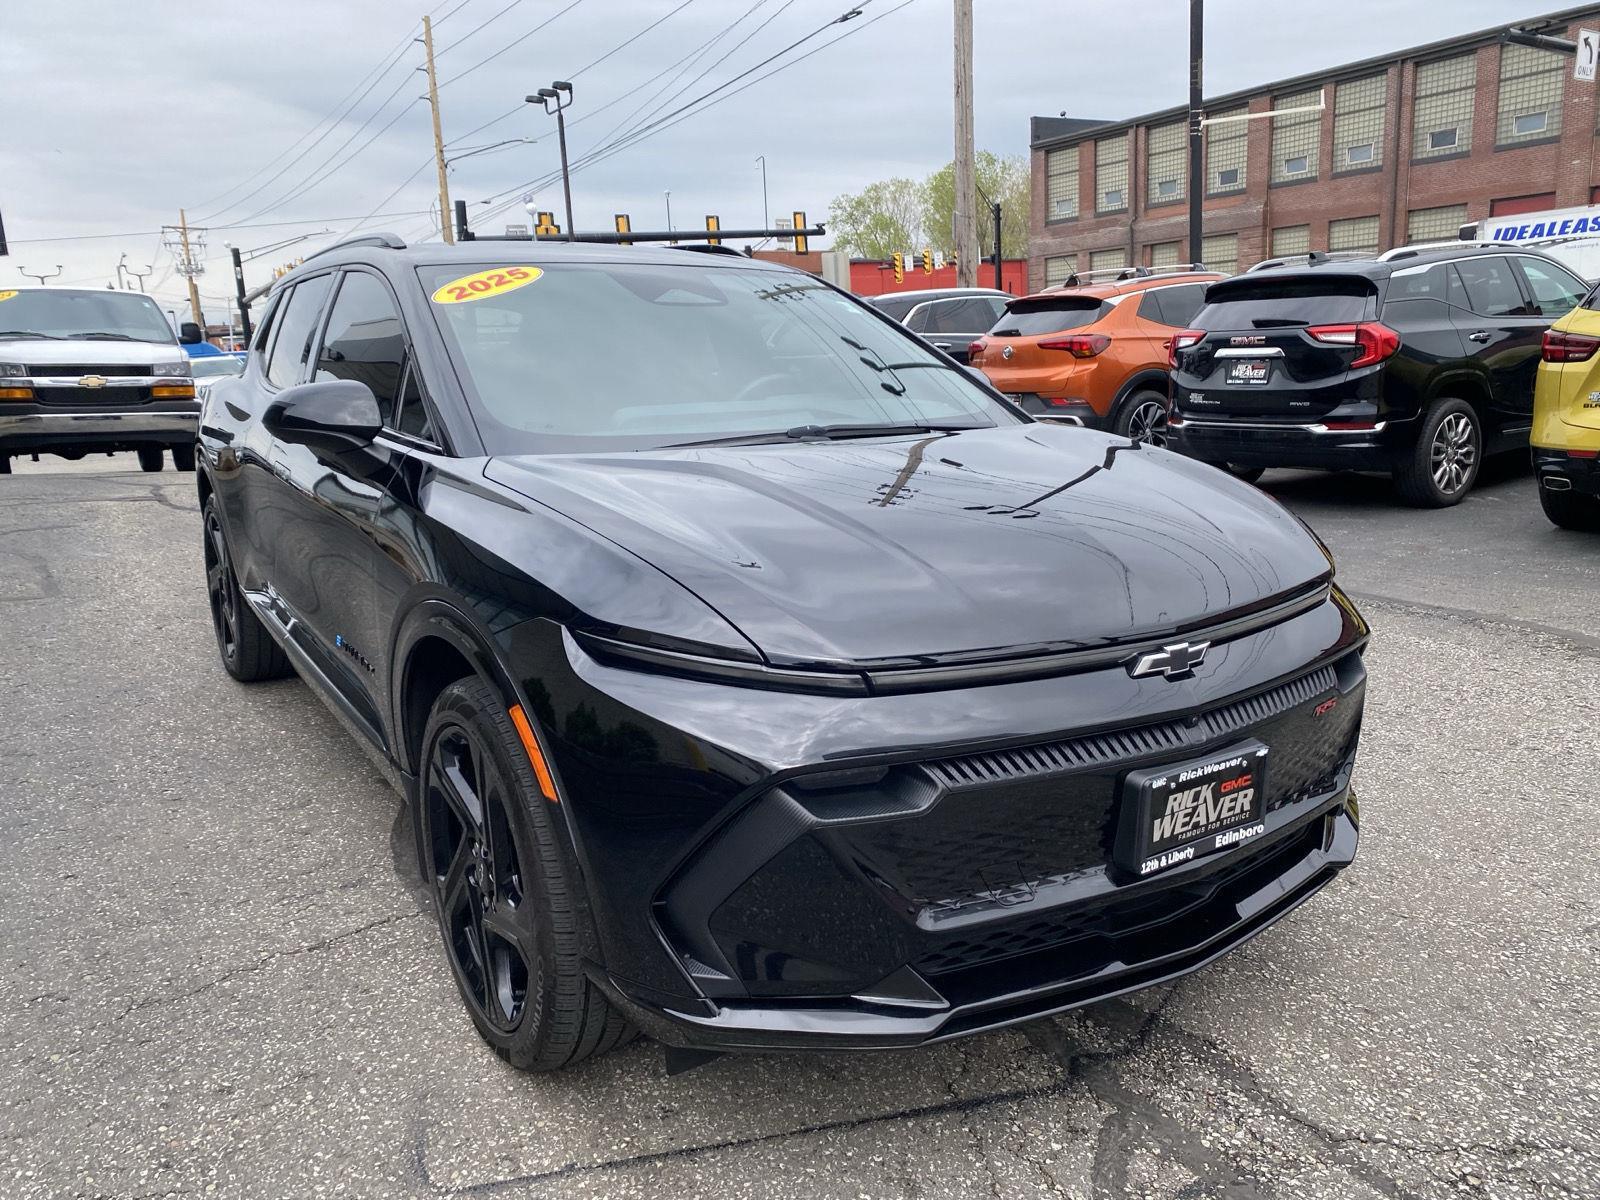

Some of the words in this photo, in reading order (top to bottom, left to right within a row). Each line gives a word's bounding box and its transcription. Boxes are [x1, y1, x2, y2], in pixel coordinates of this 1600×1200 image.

[1577, 65, 1593, 76] ONLY
[447, 268, 531, 301] 2025
[1230, 335, 1266, 346] GMC
[1232, 369, 1266, 378] WEAVER
[1312, 697, 1337, 718] RS
[1152, 778, 1168, 789] GMC
[1165, 781, 1217, 816] RICK
[1220, 774, 1252, 793] GMC
[1153, 787, 1255, 843] WEAVER
[1178, 825, 1206, 841] FAMOUS
[1207, 820, 1221, 832] FOR
[1222, 811, 1251, 826] SERVICE
[1215, 823, 1265, 848] Edinboro
[1141, 858, 1160, 875] 12th
[1160, 854, 1168, 868] &
[1168, 846, 1195, 865] Liberty
